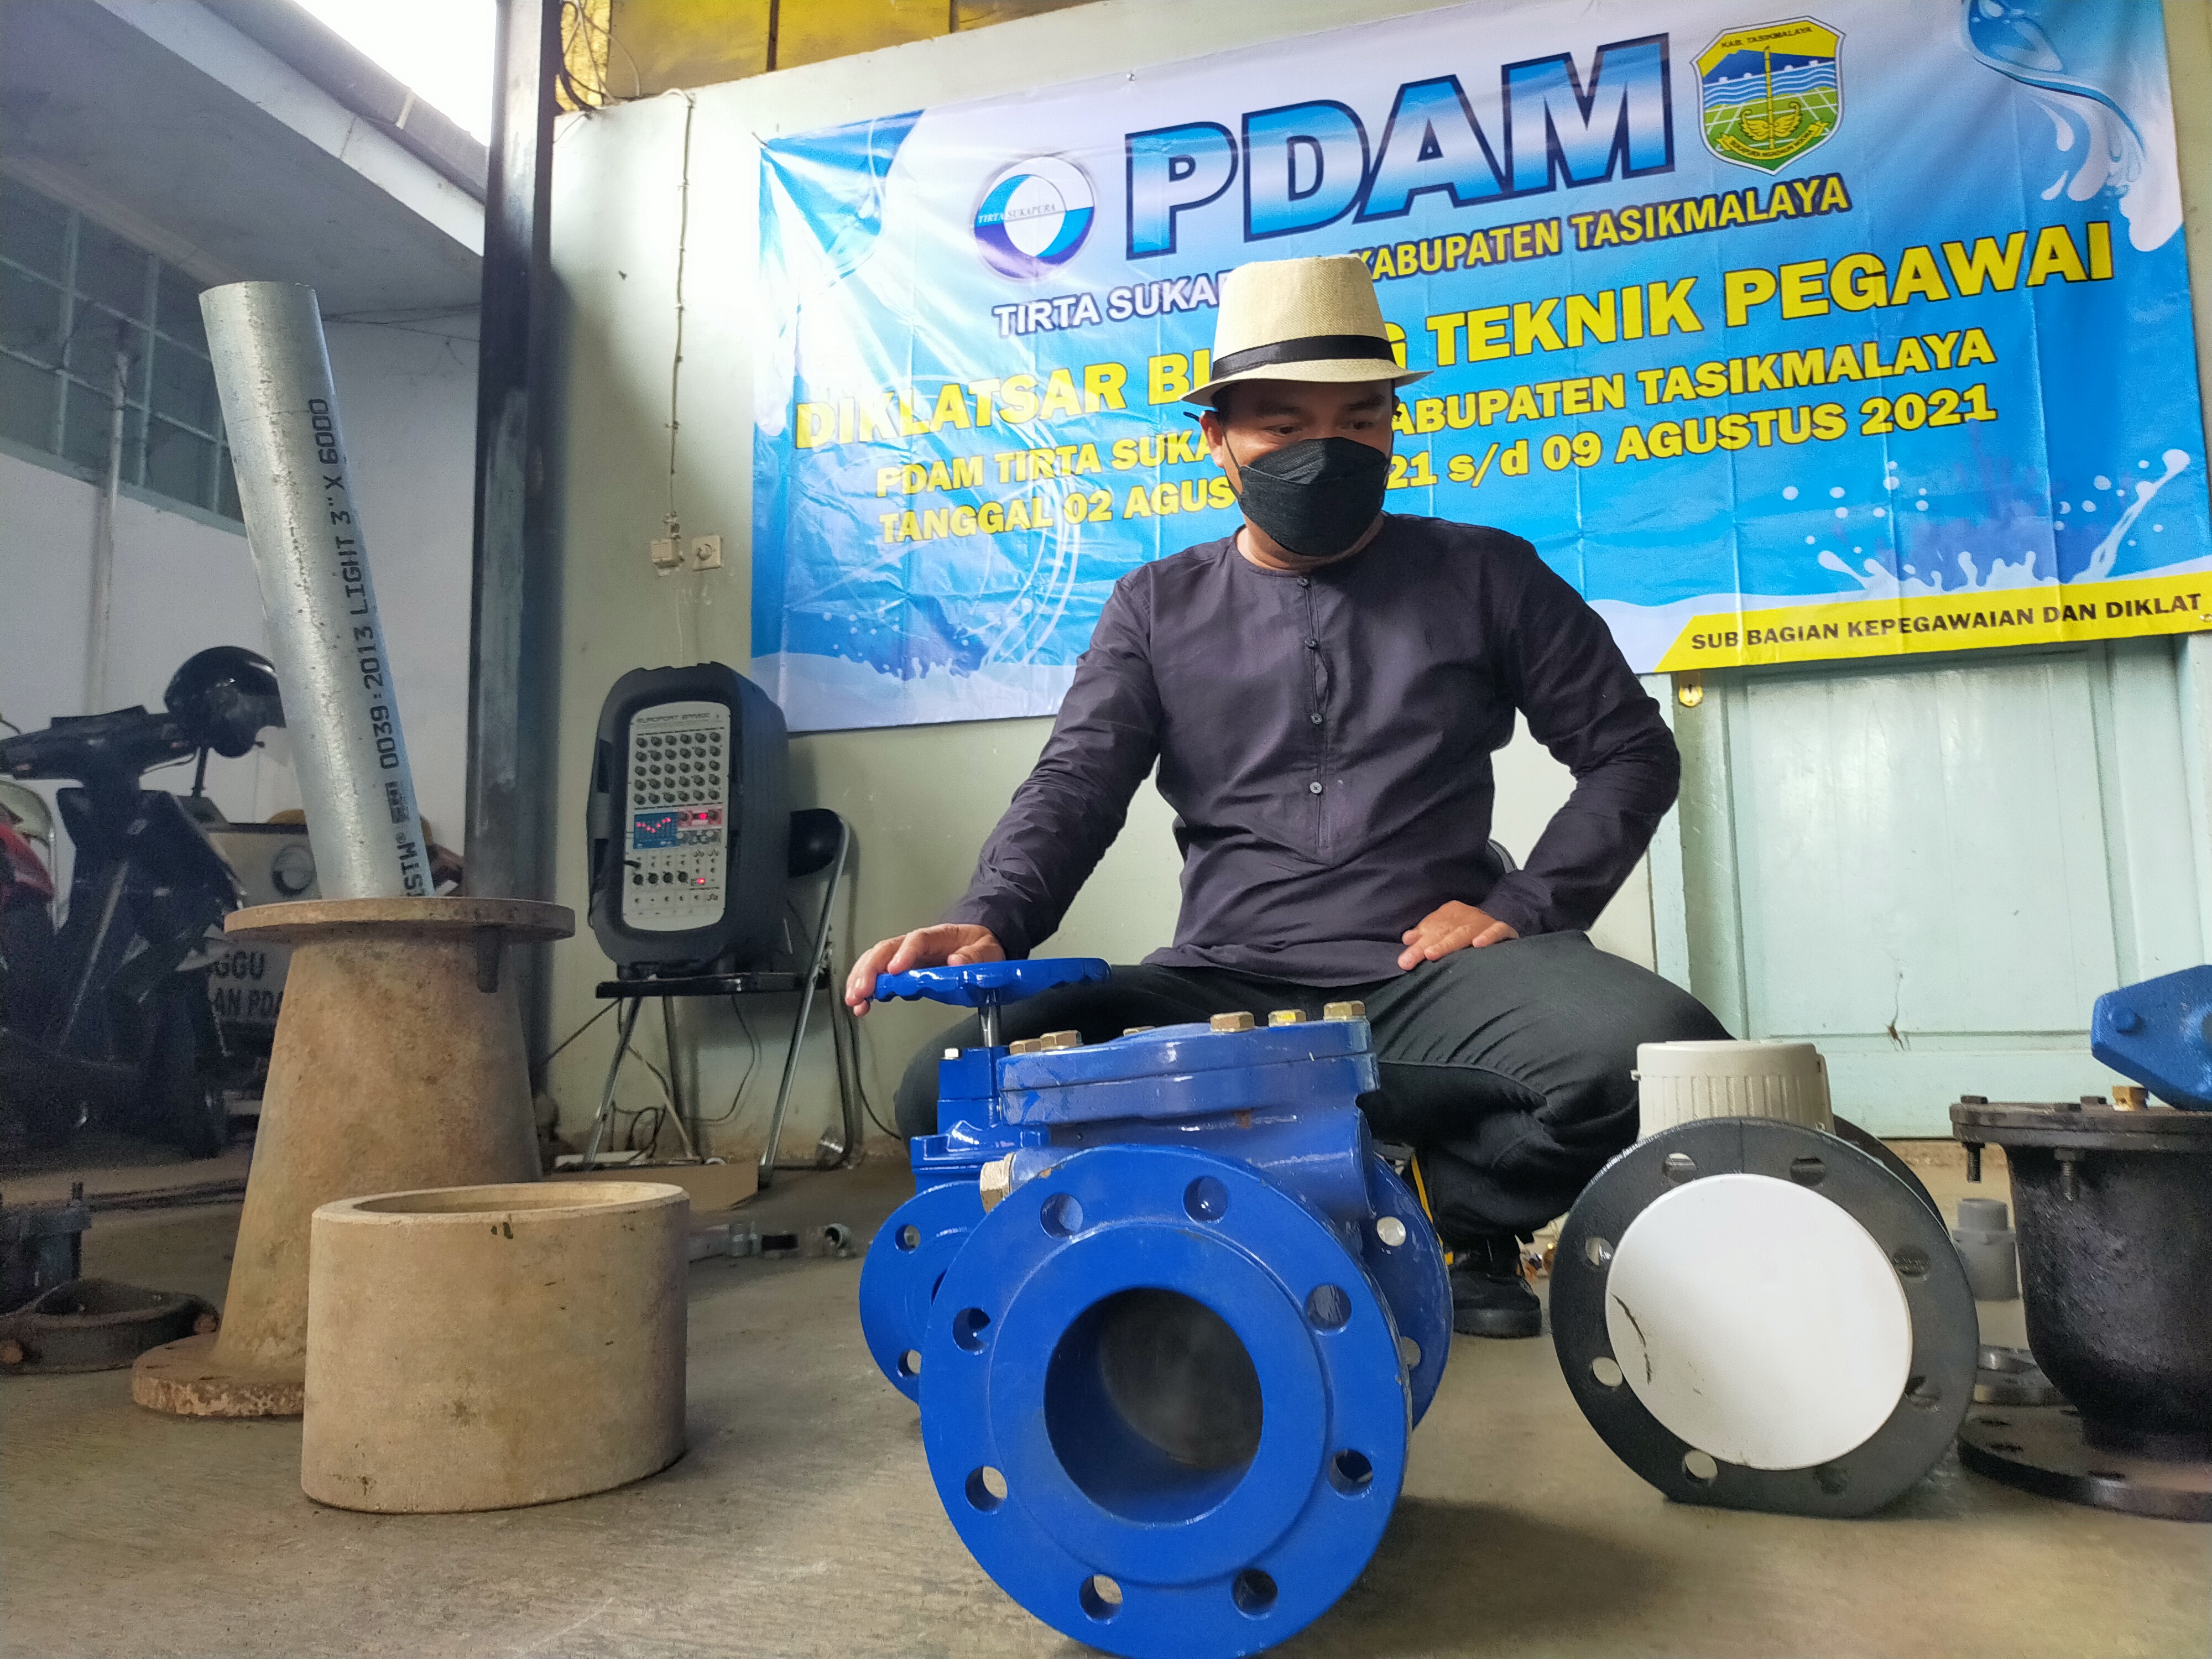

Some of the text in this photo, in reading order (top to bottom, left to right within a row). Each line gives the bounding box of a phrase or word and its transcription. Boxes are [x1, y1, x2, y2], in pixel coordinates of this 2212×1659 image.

[1125, 33, 1674, 260] PDAM
[993, 292, 1100, 338] TIRTA
[1566, 173, 1852, 252] TASIKMALAYA
[795, 362, 1128, 449] DIKLATSAR
[1426, 275, 1704, 368] TEKNIK
[1724, 222, 2114, 327] PEGAWAI
[876, 456, 984, 497] PDAM
[995, 443, 1102, 484] TIRTA
[1391, 374, 1625, 436] ABUPATEN
[1637, 327, 1996, 405] TASIKMALAYA
[308, 399, 339, 464] 6000
[323, 475, 345, 490] X
[879, 384, 1997, 543] TANGGAL 02 AGUS 21 s/d 09 AGUSTUS 2021
[335, 536, 369, 615] LIGHT
[1692, 592, 2201, 650] SUB BAGIAN KEPEGAWAIAN DAN DIKLAT
